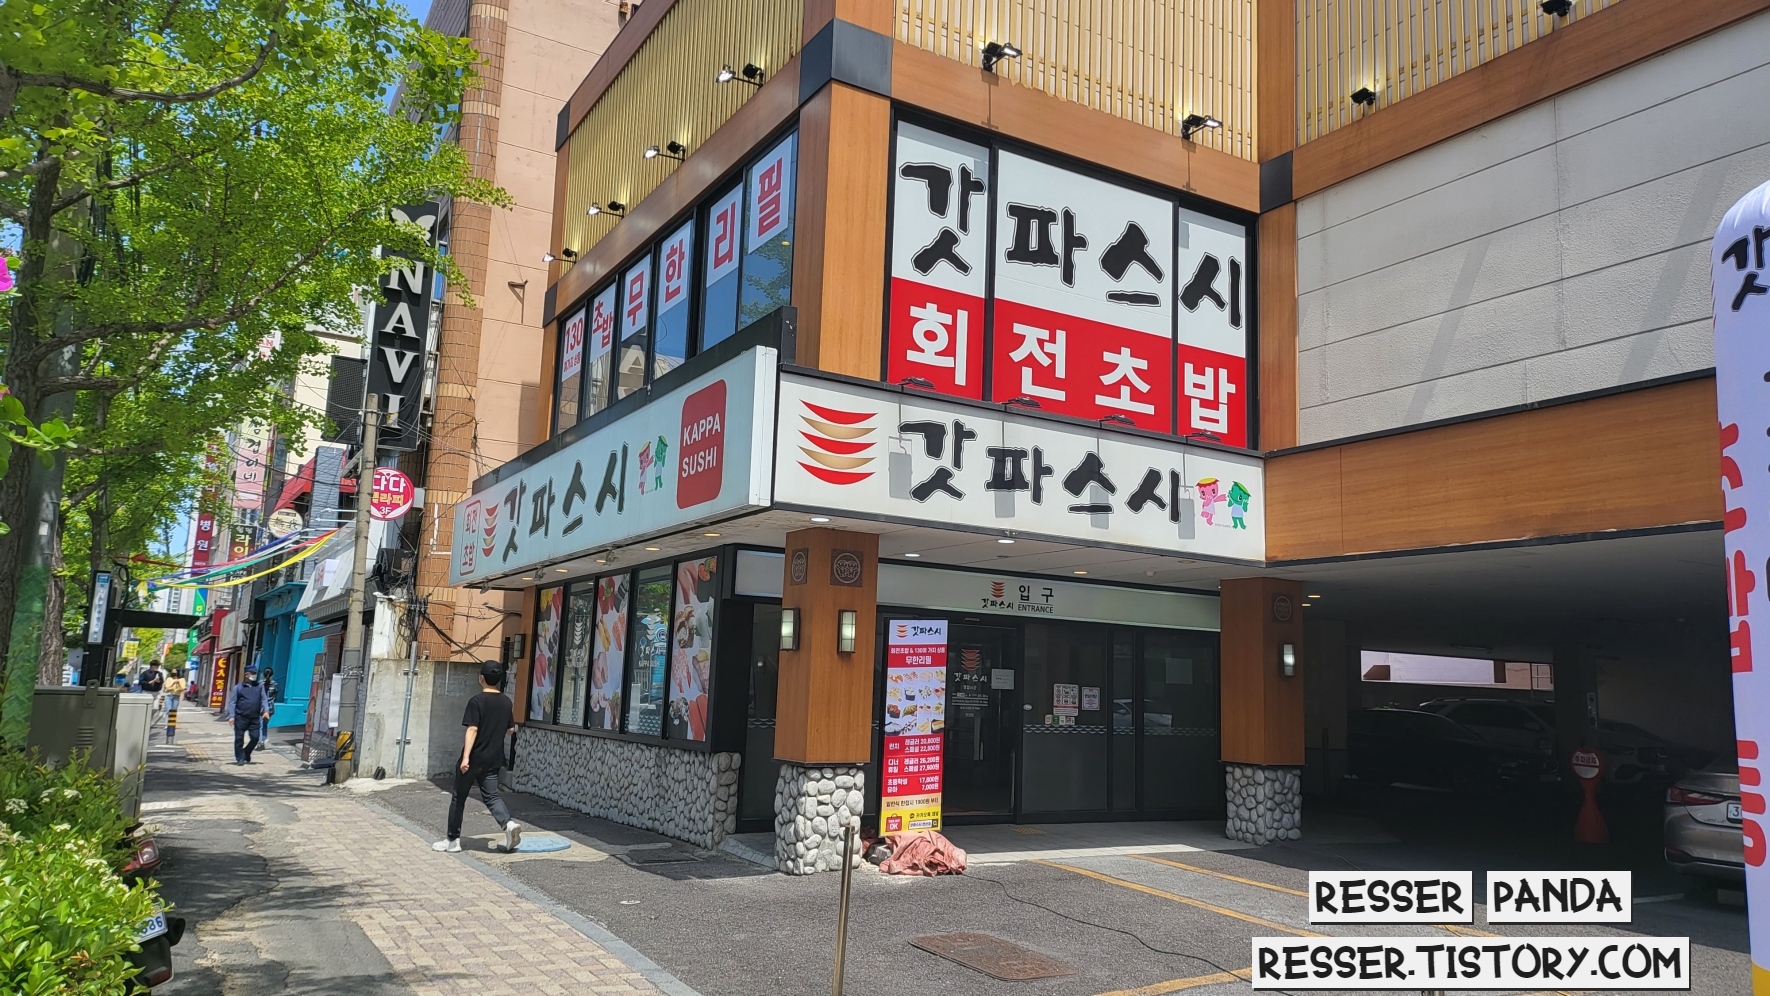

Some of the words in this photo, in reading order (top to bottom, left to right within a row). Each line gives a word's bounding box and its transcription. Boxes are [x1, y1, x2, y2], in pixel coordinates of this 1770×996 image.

[627, 157, 783, 328] 무한리필
[898, 161, 1243, 330] 갓파스시
[592, 300, 614, 349] 초밥
[379, 255, 425, 430] NAVI
[566, 317, 584, 355] 130
[905, 302, 1236, 433] 회전초밥
[683, 413, 721, 447] KAPPA
[681, 446, 718, 478] SUSHI
[898, 418, 1182, 524] 갓파스시
[379, 506, 392, 515] 3F
[502, 440, 629, 565] 갓파스시
[465, 507, 479, 536] 회전
[462, 541, 476, 567] 초밥
[981, 597, 1014, 610] 갓파스시
[1018, 585, 1054, 604] 입구
[1017, 604, 1054, 614] ENTRANCE
[911, 626, 942, 636] 갓파스시
[905, 655, 932, 665] 무한리필
[953, 672, 988, 683] 갓파스시
[889, 742, 900, 750] 런치
[887, 766, 899, 774] 휴일
[888, 758, 899, 766] 디너
[887, 778, 908, 786] 초등학생
[921, 782, 939, 791] 7,000원
